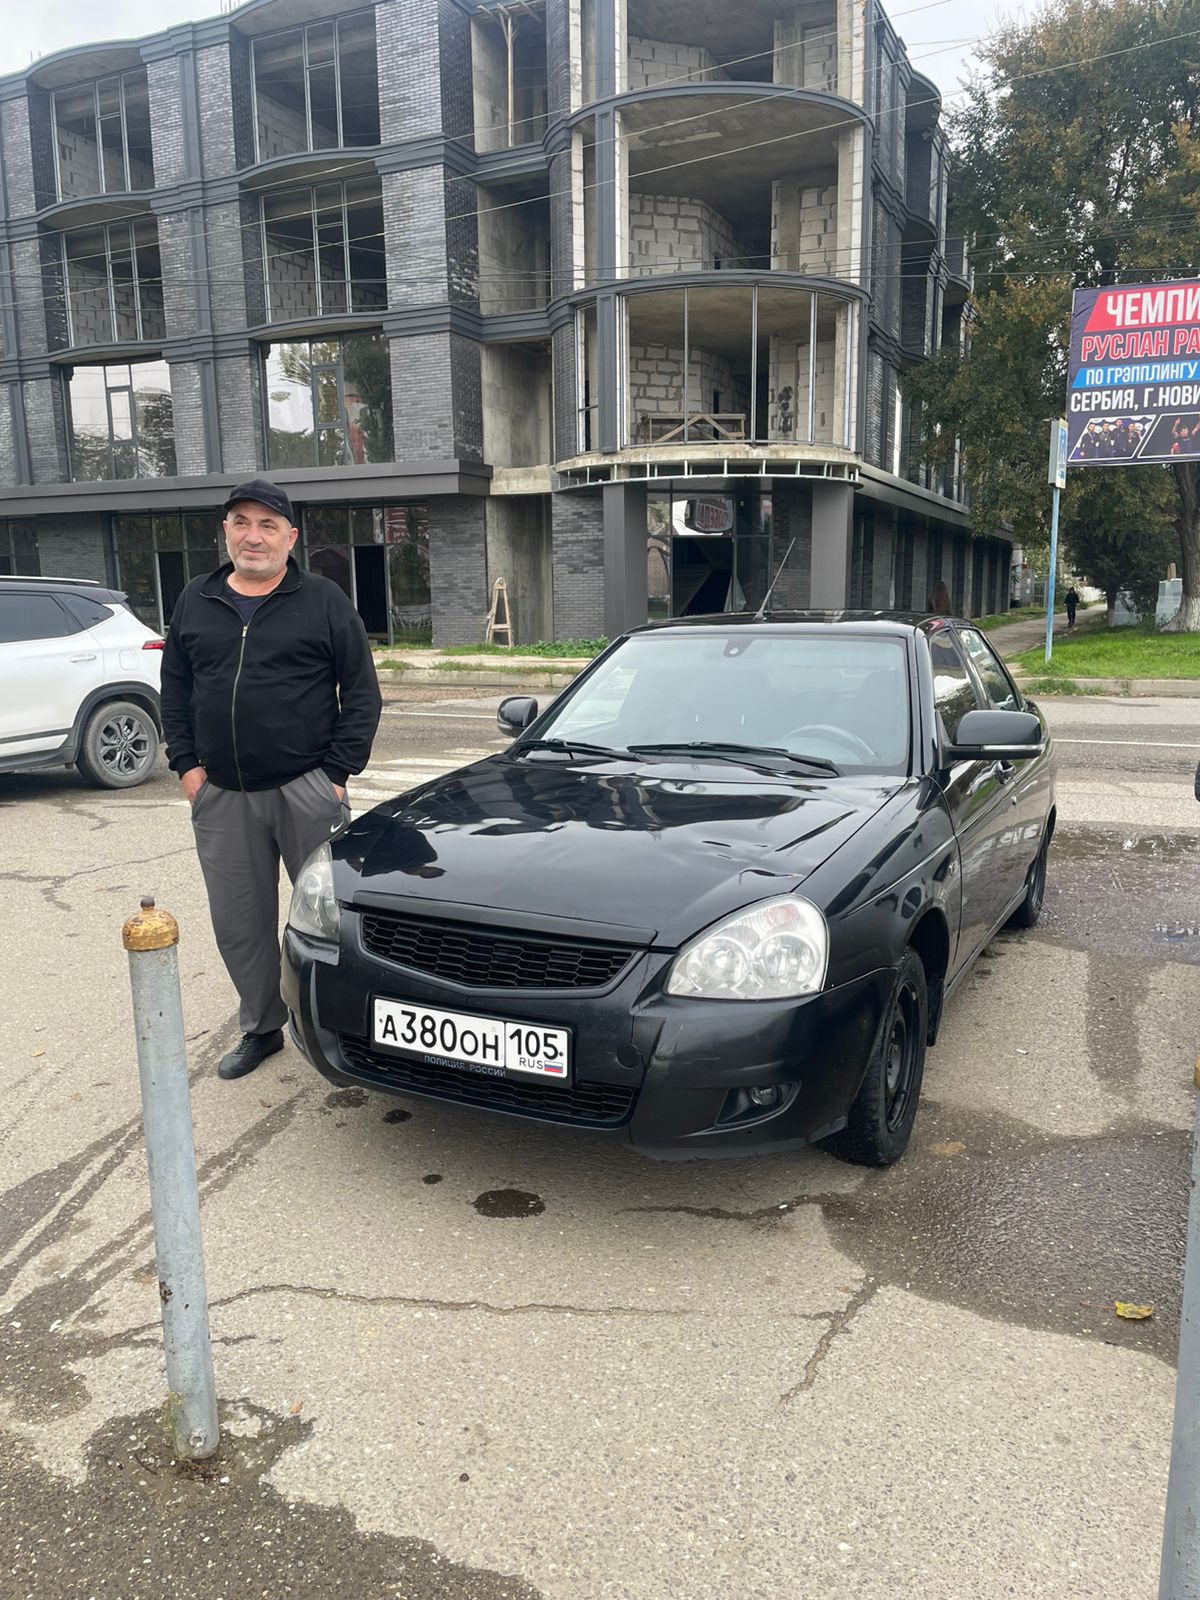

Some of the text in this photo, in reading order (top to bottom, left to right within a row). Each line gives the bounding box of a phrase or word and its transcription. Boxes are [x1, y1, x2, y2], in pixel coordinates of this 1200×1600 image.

[1106, 288, 1200, 327] ЧЕМПИ
[1080, 327, 1200, 362] РУСЛАН РА
[1085, 362, 1198, 386] ПО ГРЭППЛИНГУ
[1070, 389, 1139, 413] СЕРБИЯ,
[508, 1028, 559, 1060] 105
[424, 1055, 507, 1077] ПОЛИЦИЯ РОССИИ
[519, 1057, 544, 1070] RUS
